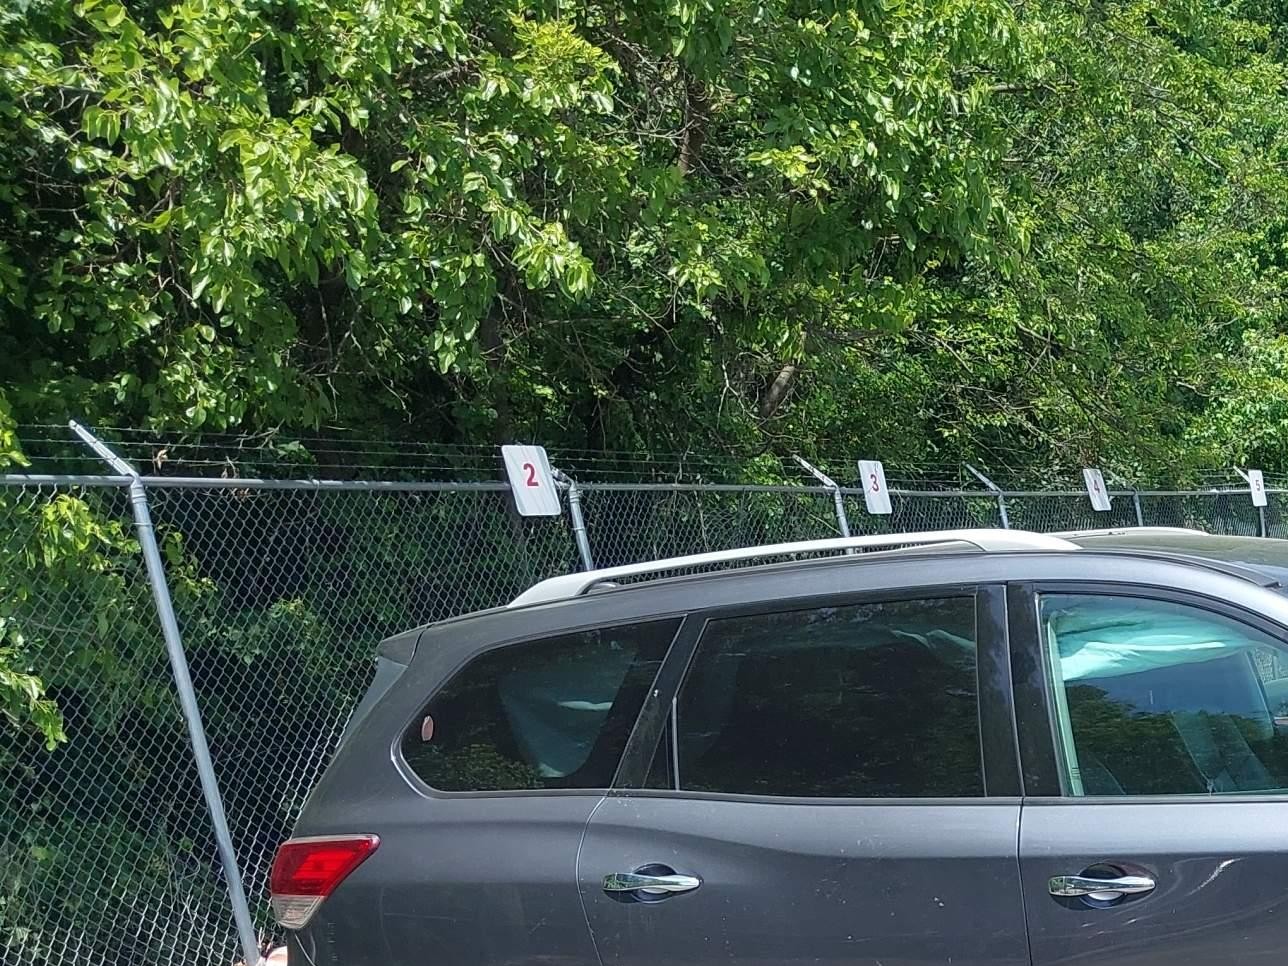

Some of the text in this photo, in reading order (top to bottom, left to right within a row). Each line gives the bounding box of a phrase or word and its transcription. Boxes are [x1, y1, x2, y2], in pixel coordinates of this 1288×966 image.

[523, 463, 539, 486] 2
[870, 473, 880, 492] 3
[1093, 479, 1101, 494] 4
[1255, 479, 1261, 492] 5
